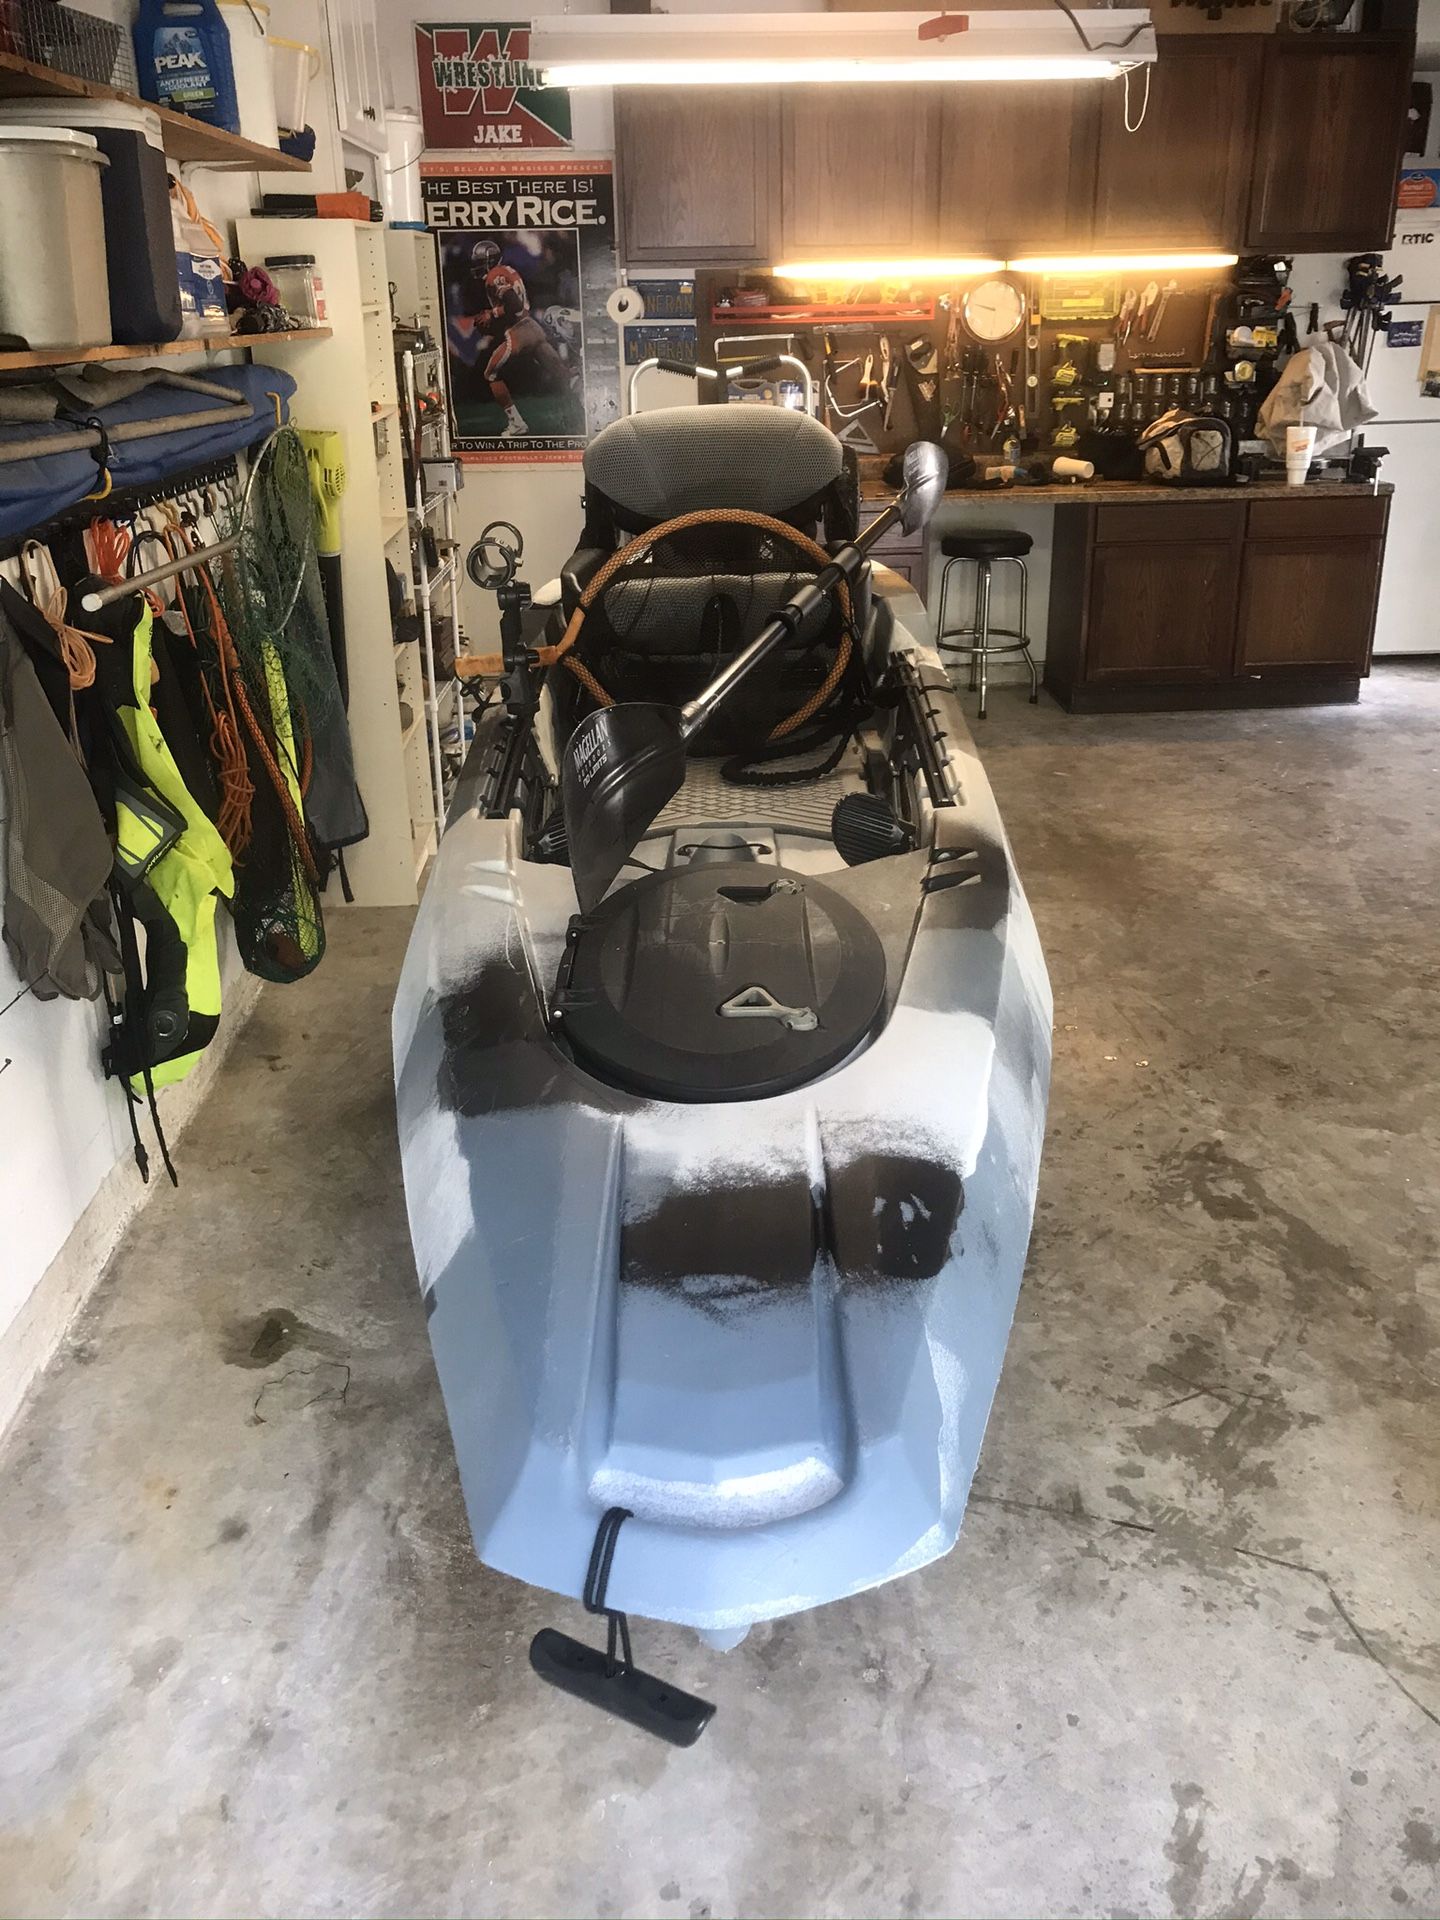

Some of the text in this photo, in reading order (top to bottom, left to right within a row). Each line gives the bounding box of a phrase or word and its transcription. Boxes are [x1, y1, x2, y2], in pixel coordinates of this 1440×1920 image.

[154, 51, 207, 74] PEAK
[160, 75, 210, 87] ANTIFREEZE
[473, 124, 523, 143] JAKE
[457, 180, 503, 195] BEST
[506, 179, 567, 194] THERE
[573, 178, 594, 193] IS!
[420, 195, 606, 229] ERRY RICE.
[1401, 232, 1435, 245] RTIC
[460, 441, 474, 450] TO
[474, 441, 496, 449] WIN
[497, 441, 505, 449] A
[506, 440, 529, 449] TRIP
[530, 440, 544, 449] TO
[544, 440, 566, 449] THE
[567, 440, 587, 448] PRO
[573, 715, 609, 772] MAGELLAN
